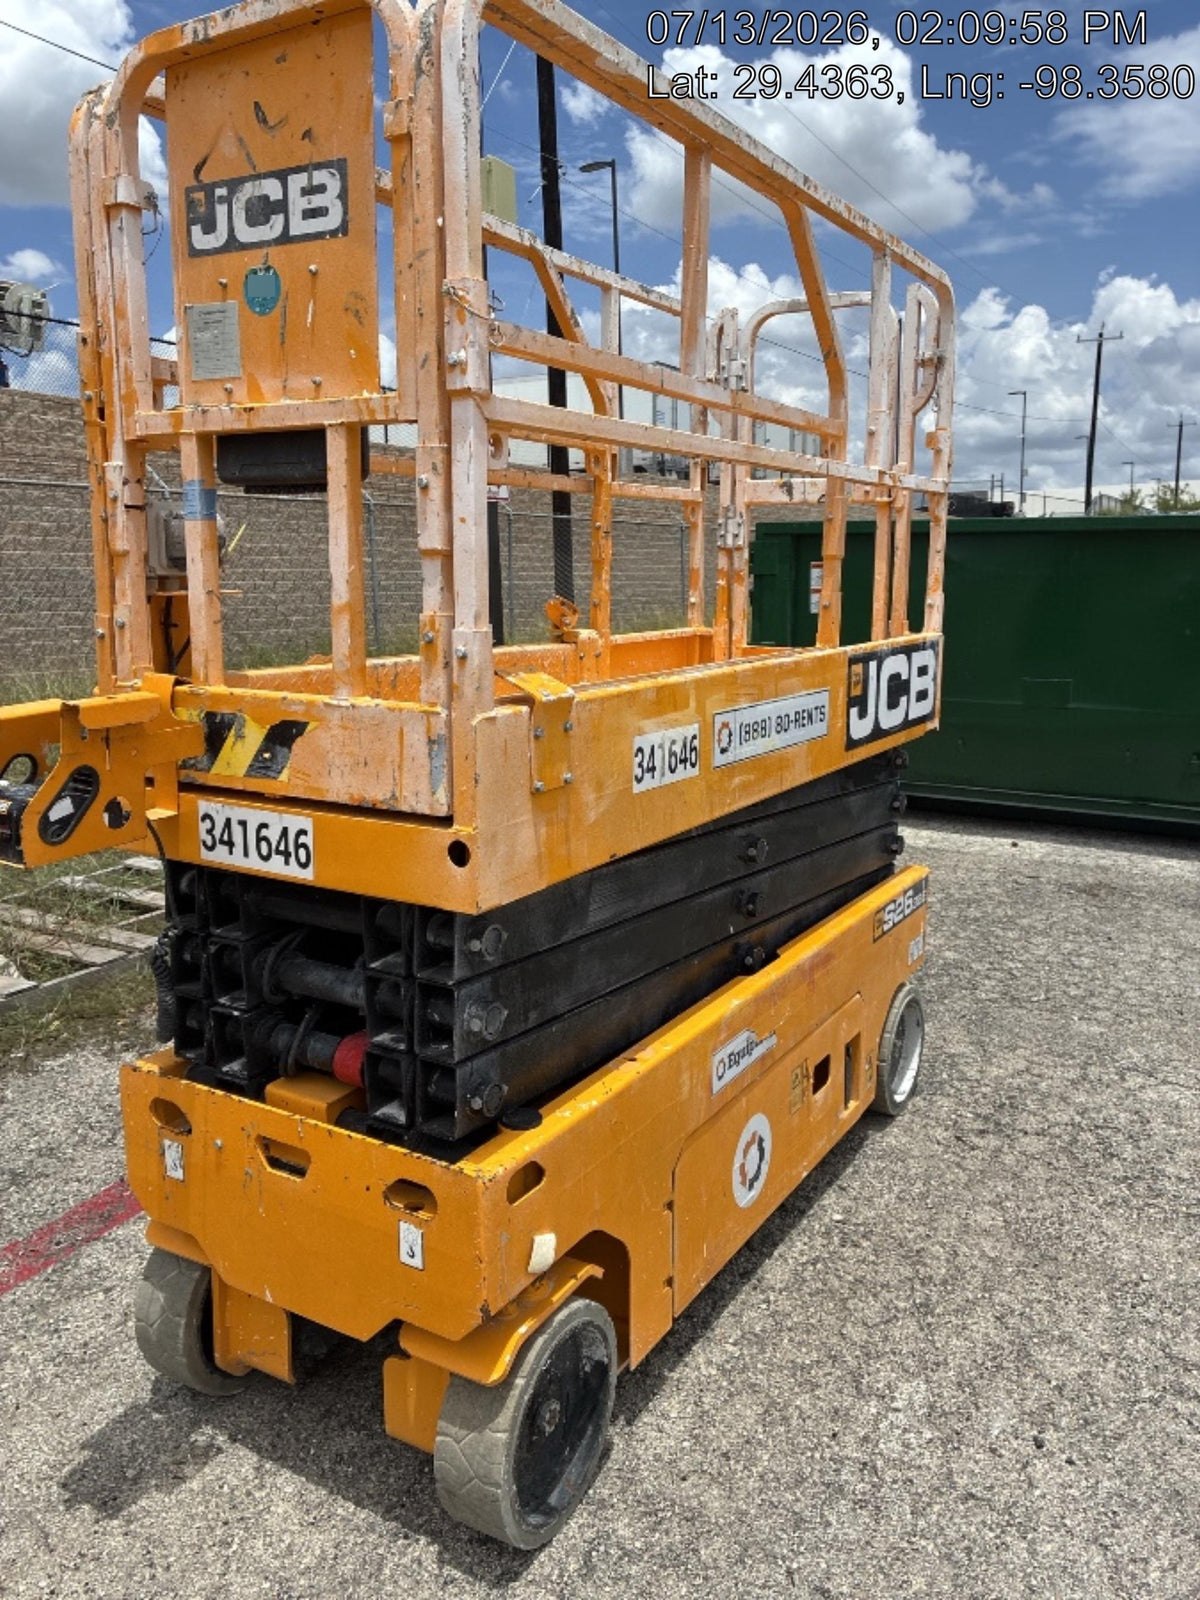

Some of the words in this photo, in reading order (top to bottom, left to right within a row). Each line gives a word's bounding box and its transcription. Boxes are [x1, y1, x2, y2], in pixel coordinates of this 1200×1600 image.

[190, 168, 344, 250] JCB
[849, 648, 937, 741] JCB
[634, 733, 698, 785] 341646
[200, 812, 312, 870] 341646
